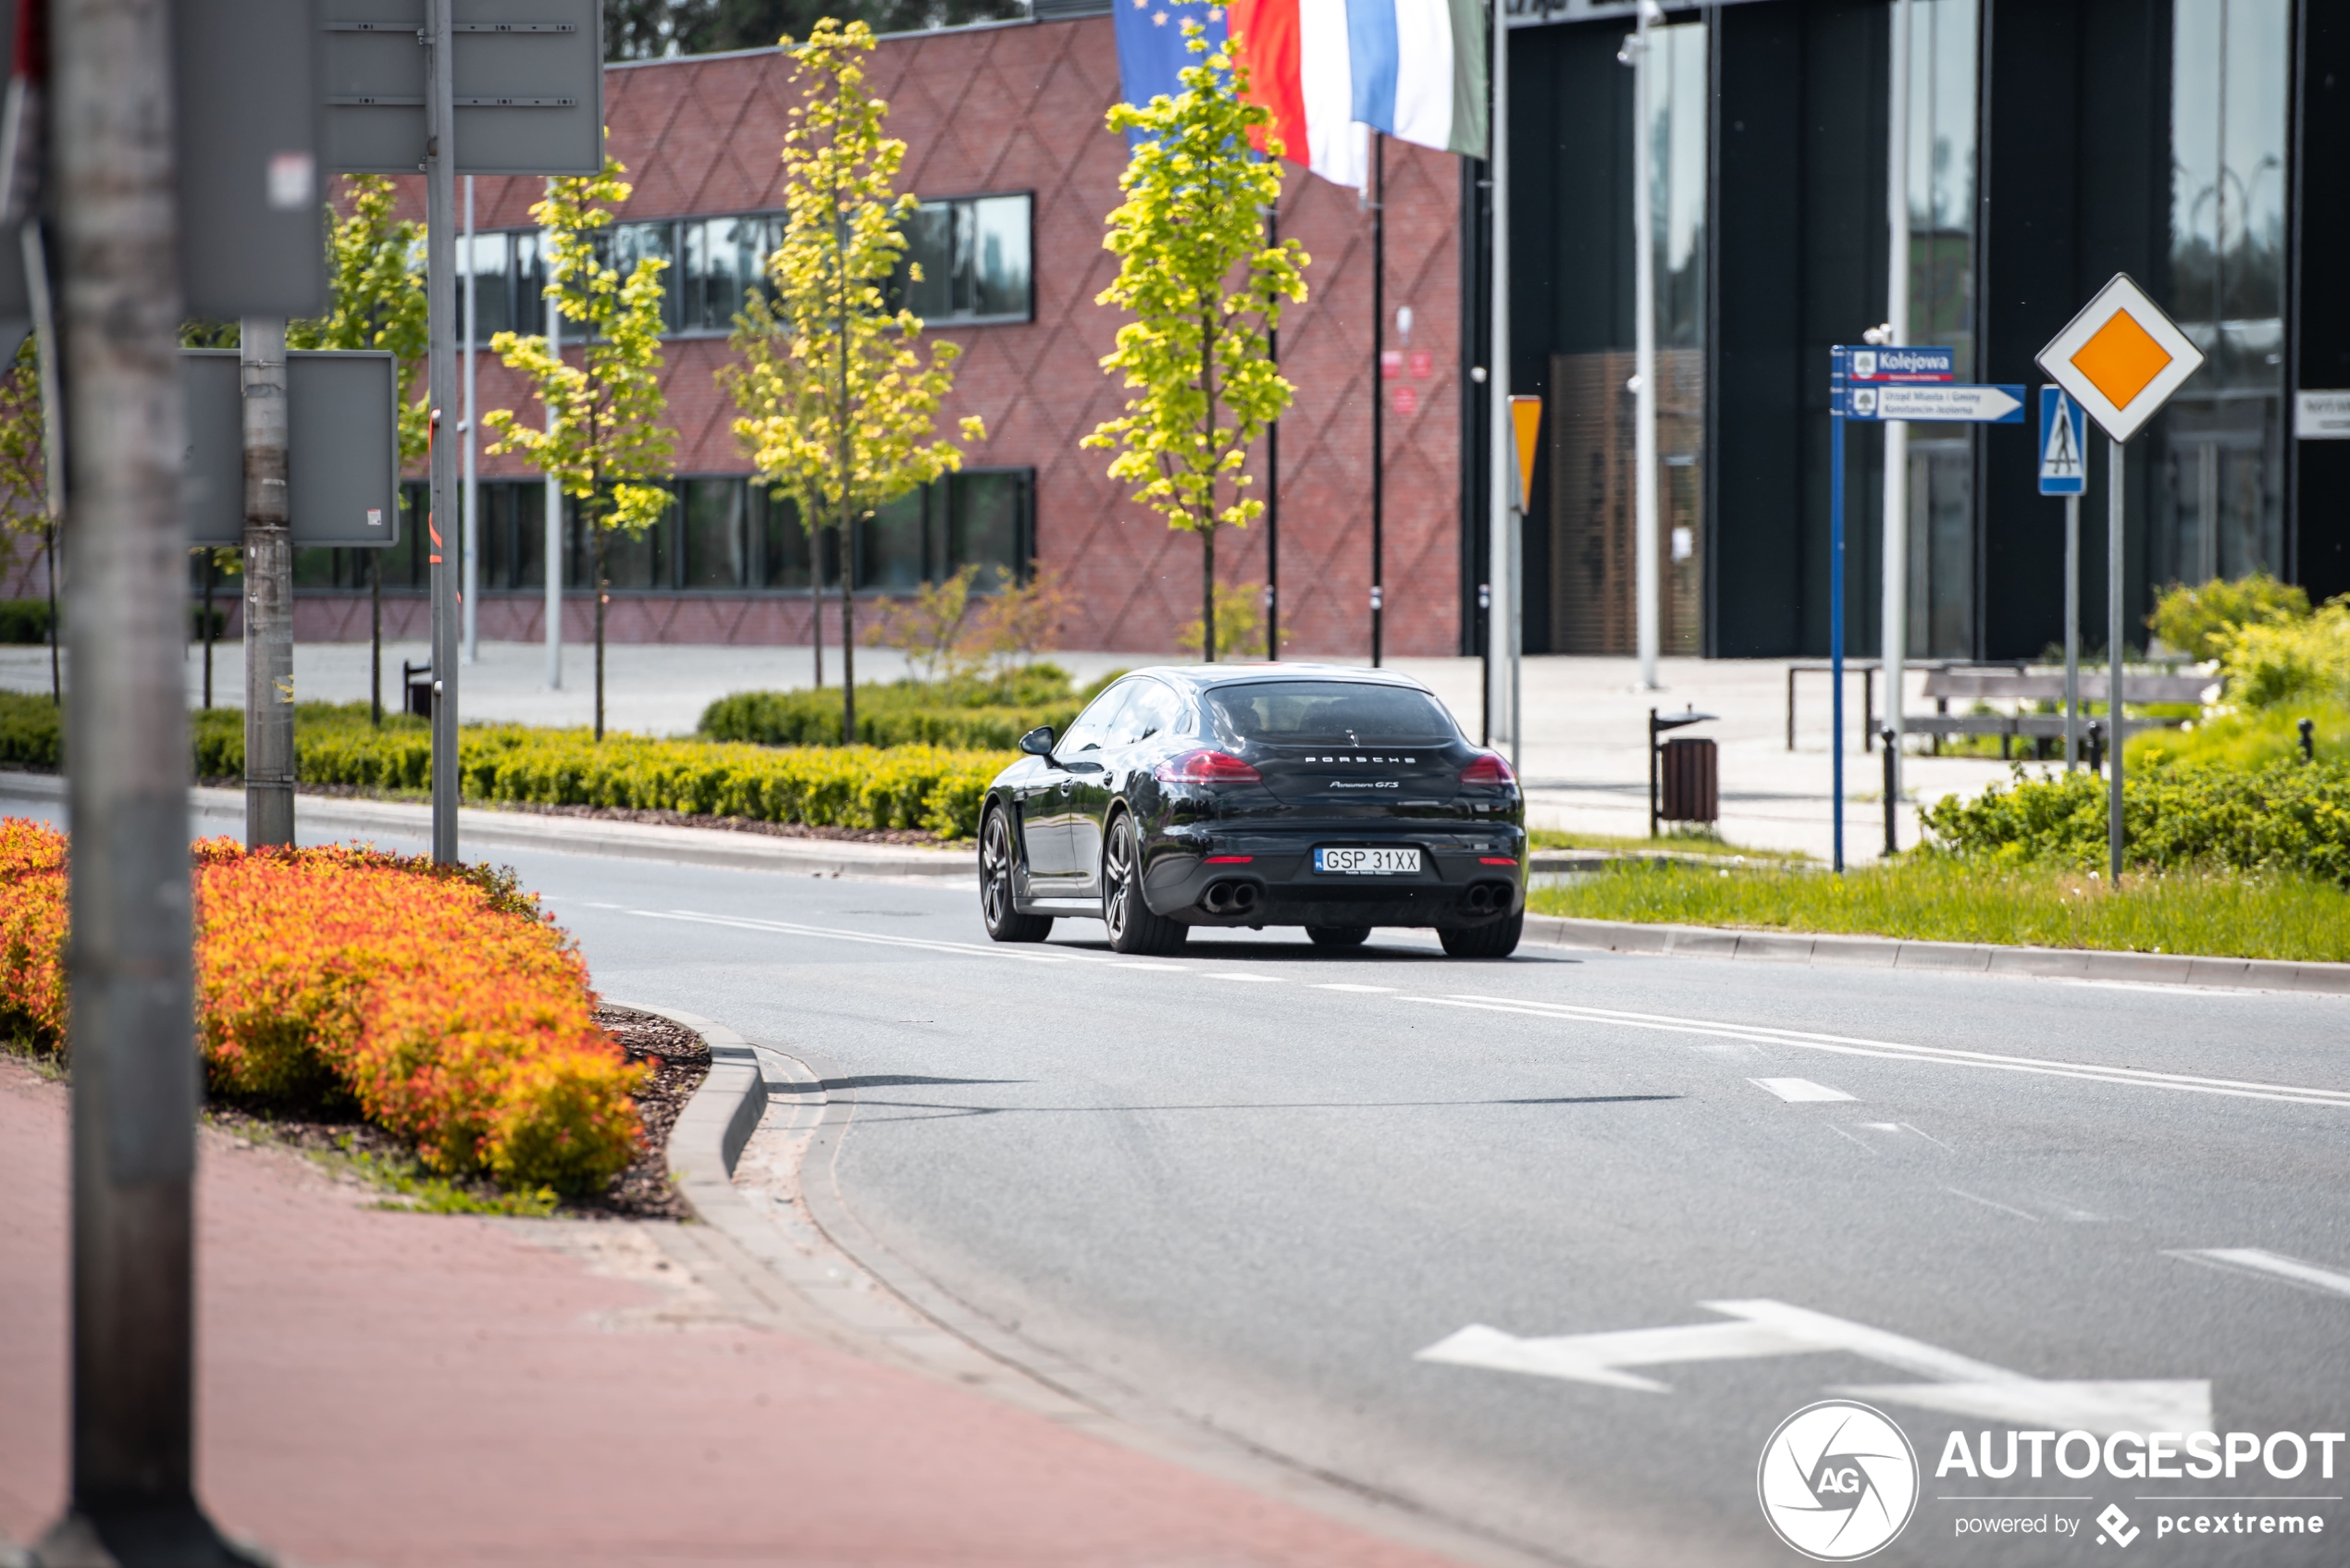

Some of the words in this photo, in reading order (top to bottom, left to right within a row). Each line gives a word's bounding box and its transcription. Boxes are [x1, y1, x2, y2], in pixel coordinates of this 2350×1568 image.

[1879, 352, 1949, 373] Kolejowa
[1327, 851, 1367, 870] GSP
[1373, 851, 1417, 870] 31XX
